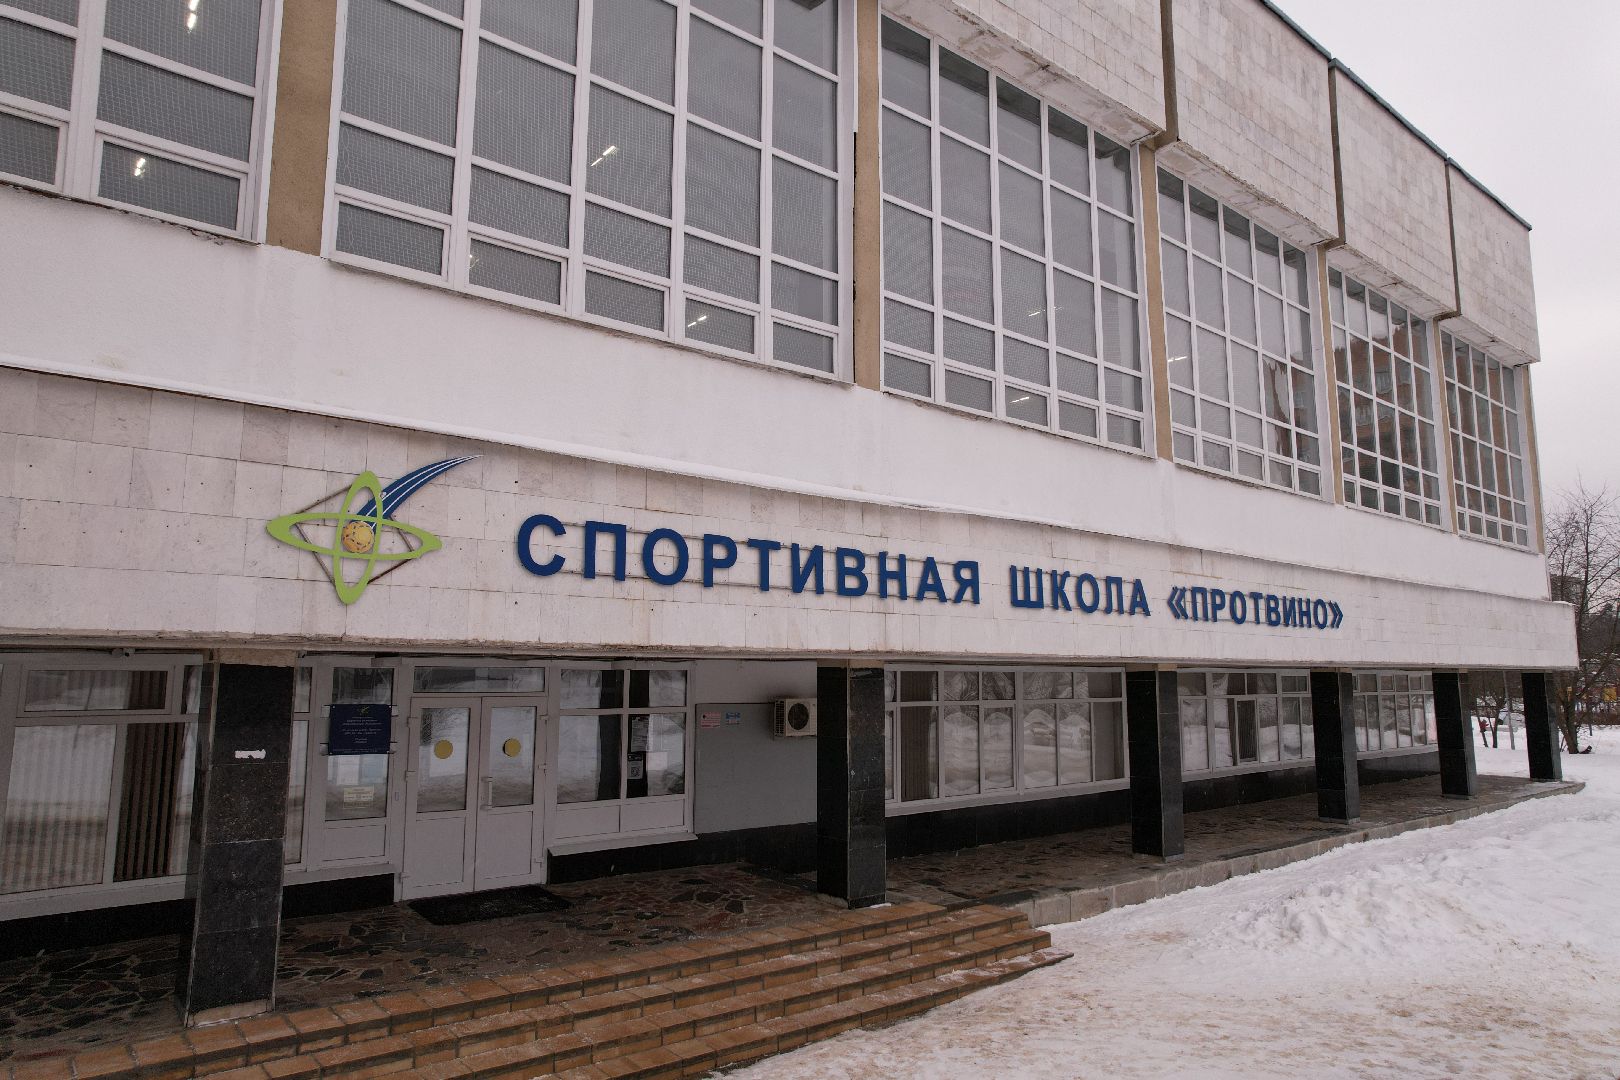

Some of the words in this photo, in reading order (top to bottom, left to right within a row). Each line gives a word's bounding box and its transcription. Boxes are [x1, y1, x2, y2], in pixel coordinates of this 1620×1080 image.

[517, 514, 980, 605] СПОРТИВНАЯ
[1009, 565, 1151, 616] ШКОЛА
[1167, 586, 1343, 629] «ПРОТВИНО»
